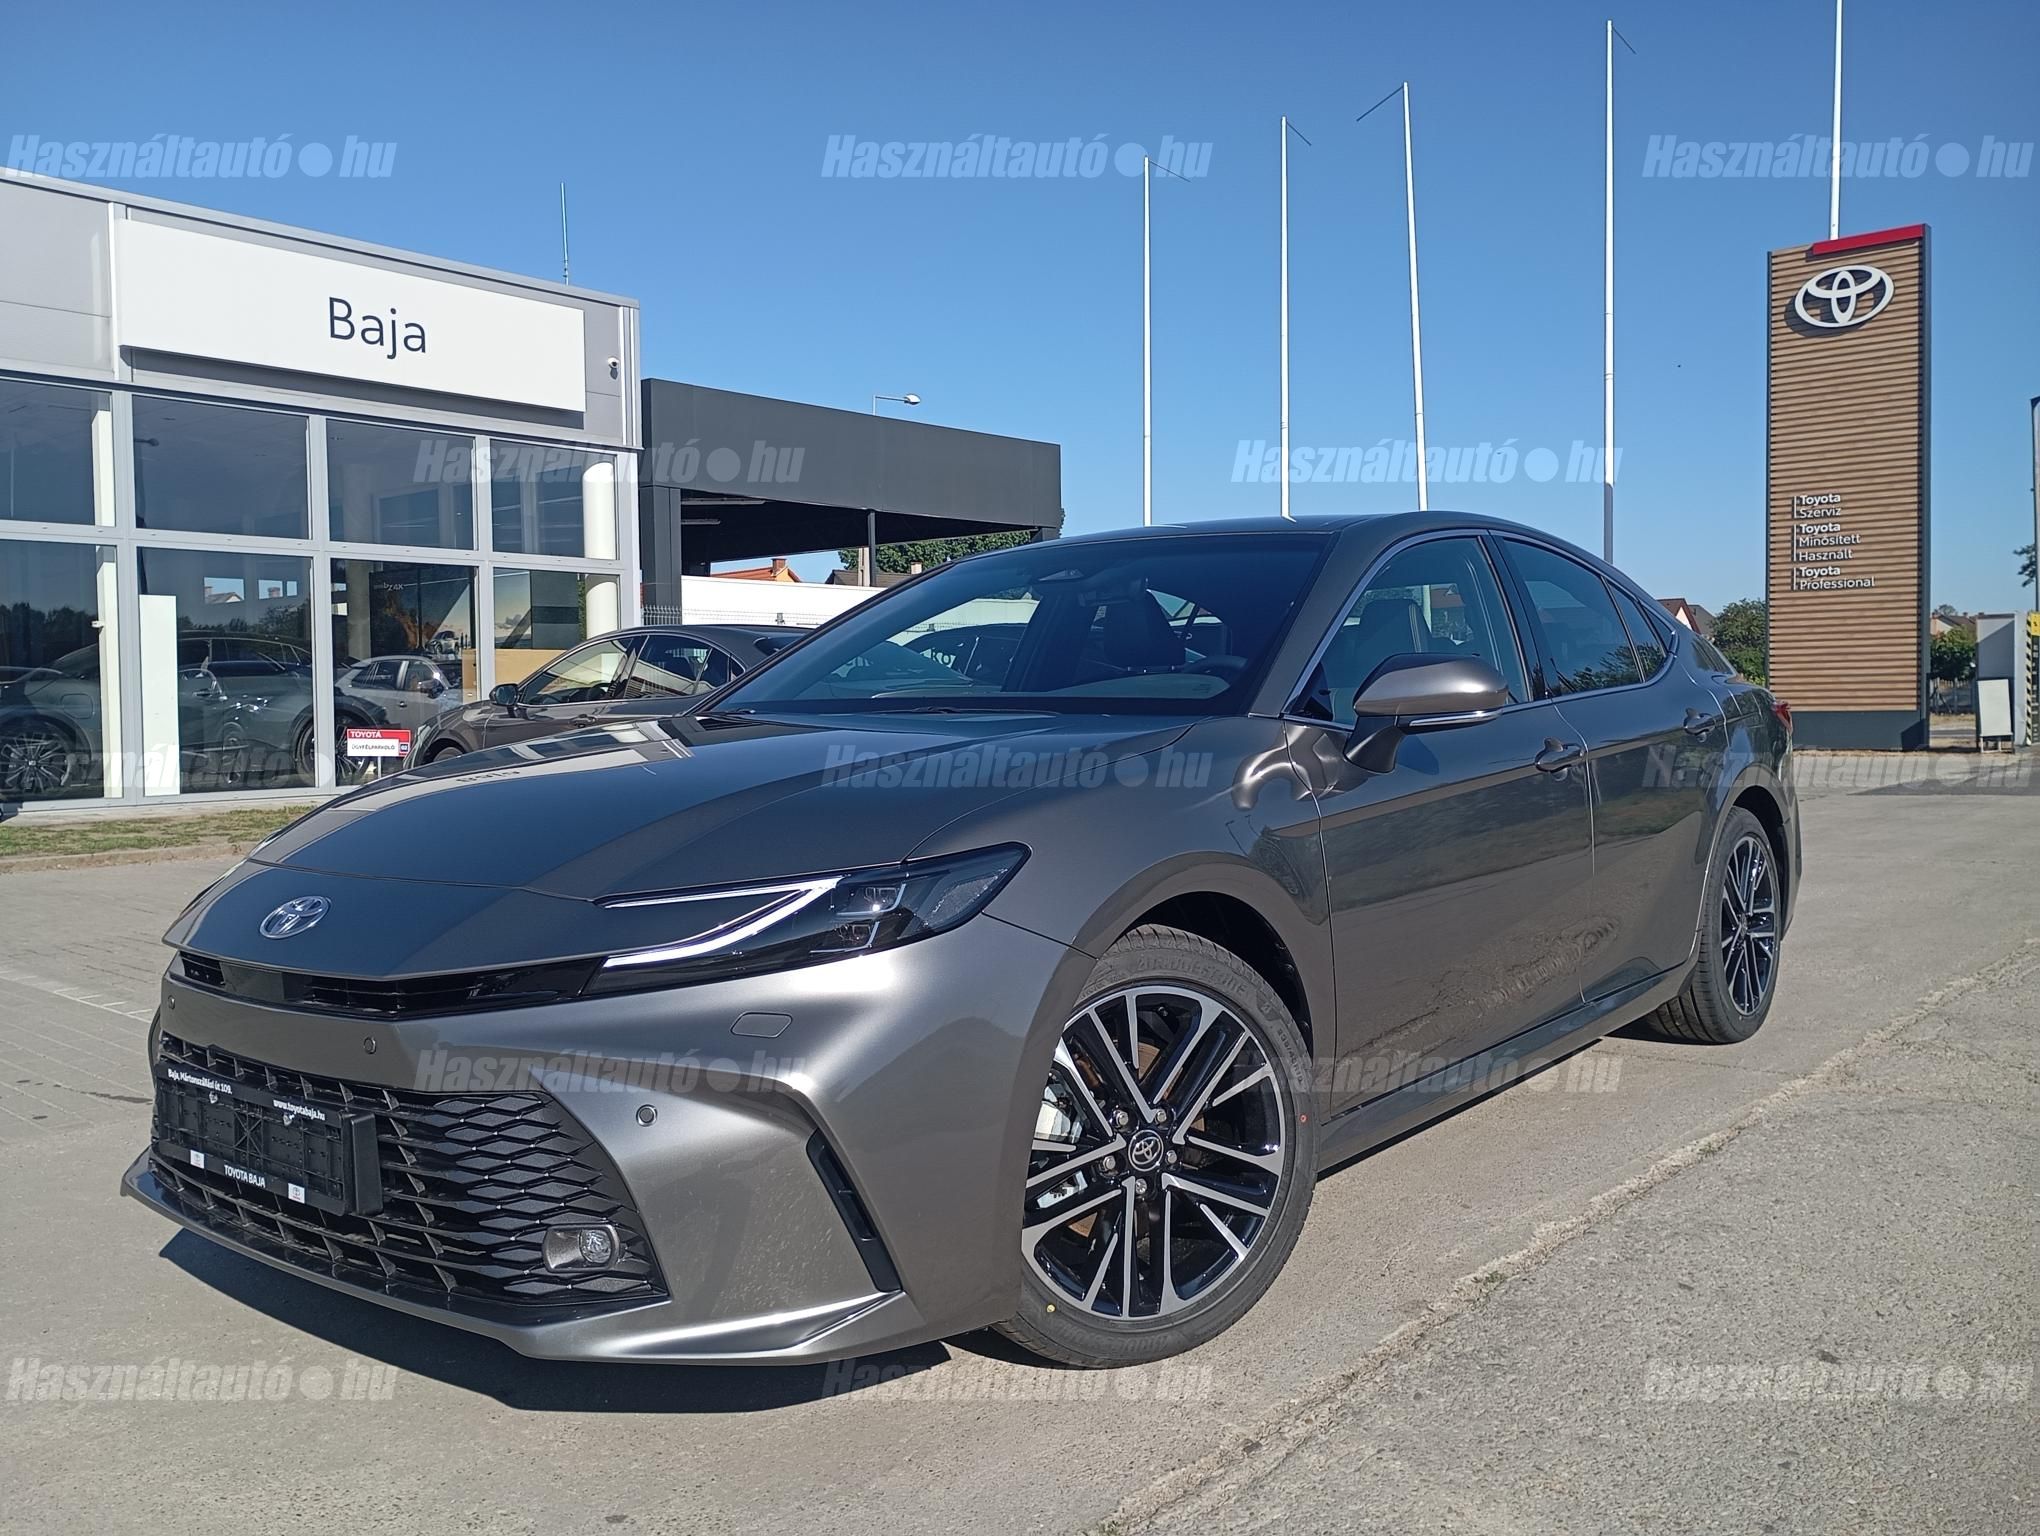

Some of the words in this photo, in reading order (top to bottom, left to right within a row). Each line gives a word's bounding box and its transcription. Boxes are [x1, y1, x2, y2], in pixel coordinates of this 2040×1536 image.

[329, 297, 426, 359] Baja
[1800, 494, 1840, 506] Toyota
[1800, 507, 1841, 518] Szerviz
[1800, 523, 1840, 534] Toyota
[1800, 549, 1853, 561] Használt
[1800, 566, 1840, 578] Toyota
[1800, 576, 1875, 590] Professional
[350, 730, 382, 738] TOYOTA
[224, 1164, 248, 1182] TOYOTA
[248, 1173, 266, 1188] BAJA
